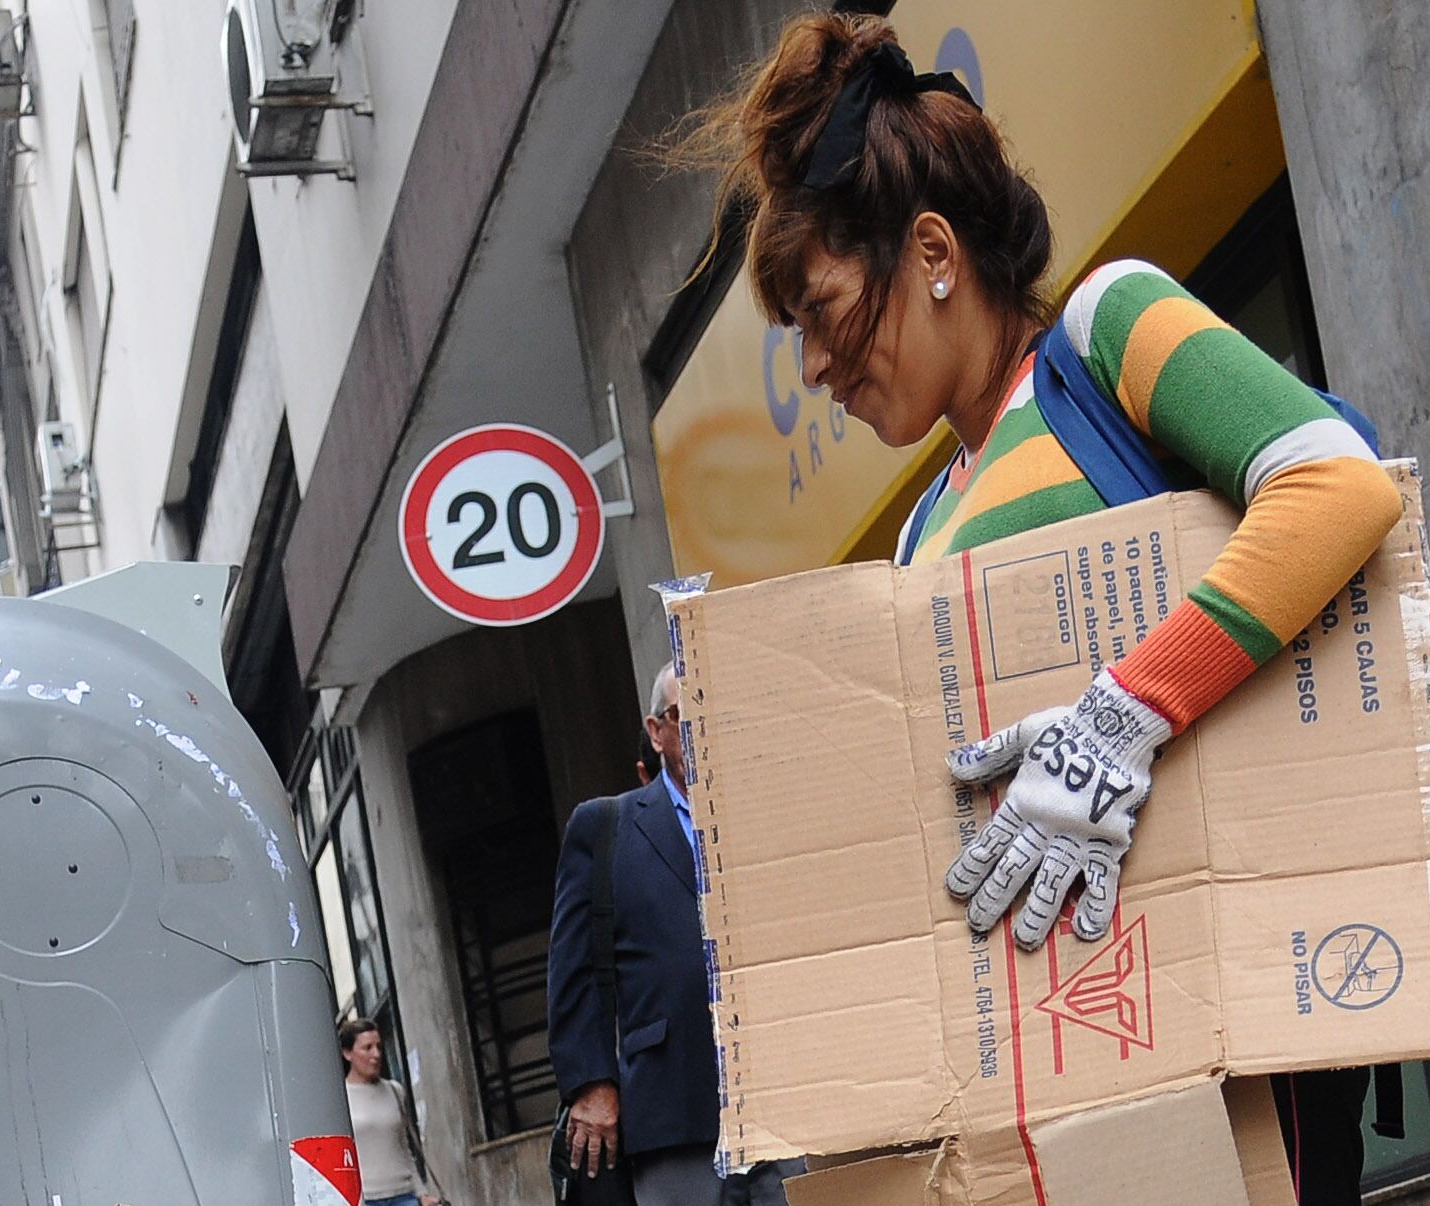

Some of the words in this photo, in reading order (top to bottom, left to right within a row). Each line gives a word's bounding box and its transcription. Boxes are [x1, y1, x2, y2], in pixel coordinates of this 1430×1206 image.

[447, 482, 562, 570] 20
[1125, 536, 1140, 560] 10
[1077, 546, 1094, 600] super
[1101, 541, 1115, 565] de
[931, 595, 954, 648] JOAQUIN
[1054, 573, 1071, 644] CODIGO
[1102, 570, 1123, 630] papel,
[1354, 622, 1370, 635] 5
[938, 649, 955, 663] V.
[1356, 640, 1380, 713] CAJAS
[939, 664, 964, 729] GONZALEZ
[1295, 657, 1318, 723] PISOS
[950, 781, 976, 818] 1651)
[1029, 722, 1134, 824] Aesa
[1291, 931, 1307, 958] NO
[1293, 962, 1312, 1015] PISAR
